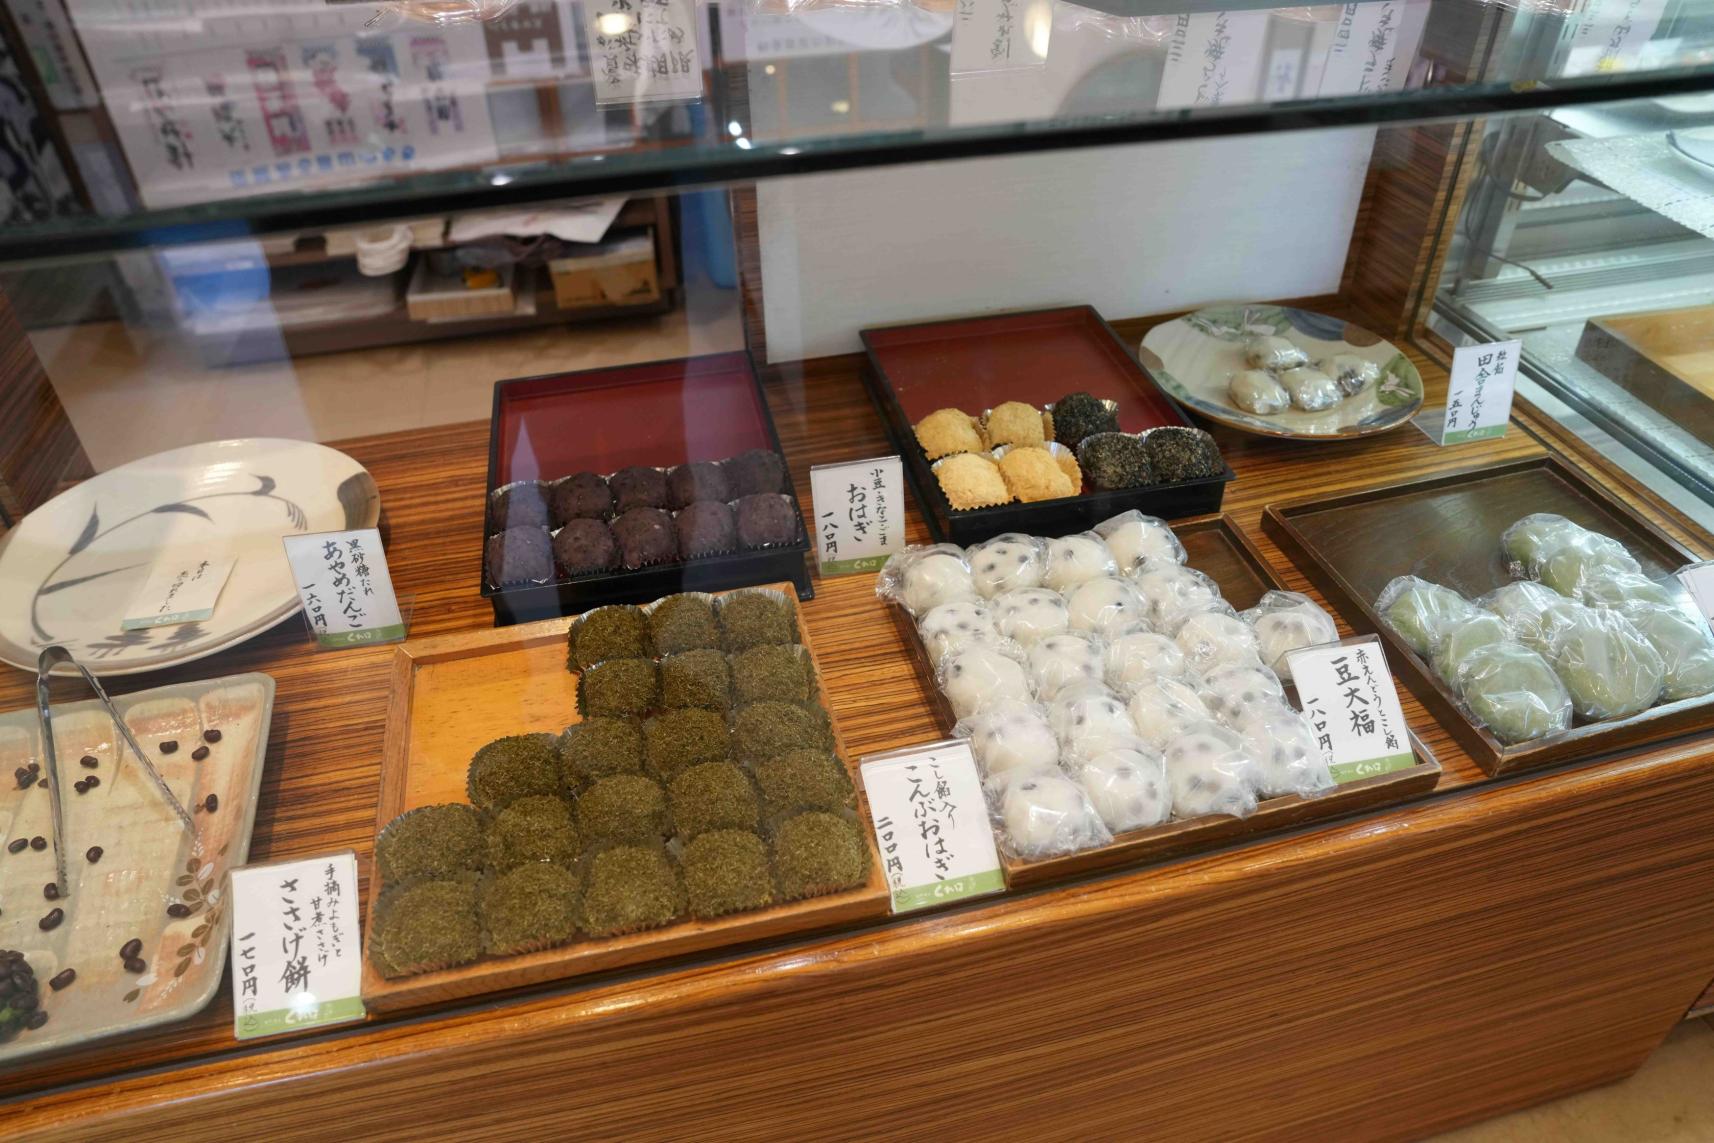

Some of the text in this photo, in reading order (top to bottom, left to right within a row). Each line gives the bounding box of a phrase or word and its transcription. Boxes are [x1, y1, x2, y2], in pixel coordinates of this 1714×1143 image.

[1467, 352, 1494, 438] 田舎まんじゅう
[846, 482, 873, 543] おはぎ
[321, 539, 368, 629] あやめだんご
[345, 537, 375, 599] 黒砂糖たれ
[1330, 655, 1376, 738] 豆大福
[1355, 647, 1400, 751] 赤えんどうとこし餡
[904, 764, 956, 882] こんぶおはぎ
[928, 756, 959, 830] こし餡入り
[277, 877, 312, 994] ささげ餅
[309, 896, 330, 968] 甘煮ささげ
[323, 862, 345, 959] 手摘みよもぎと
